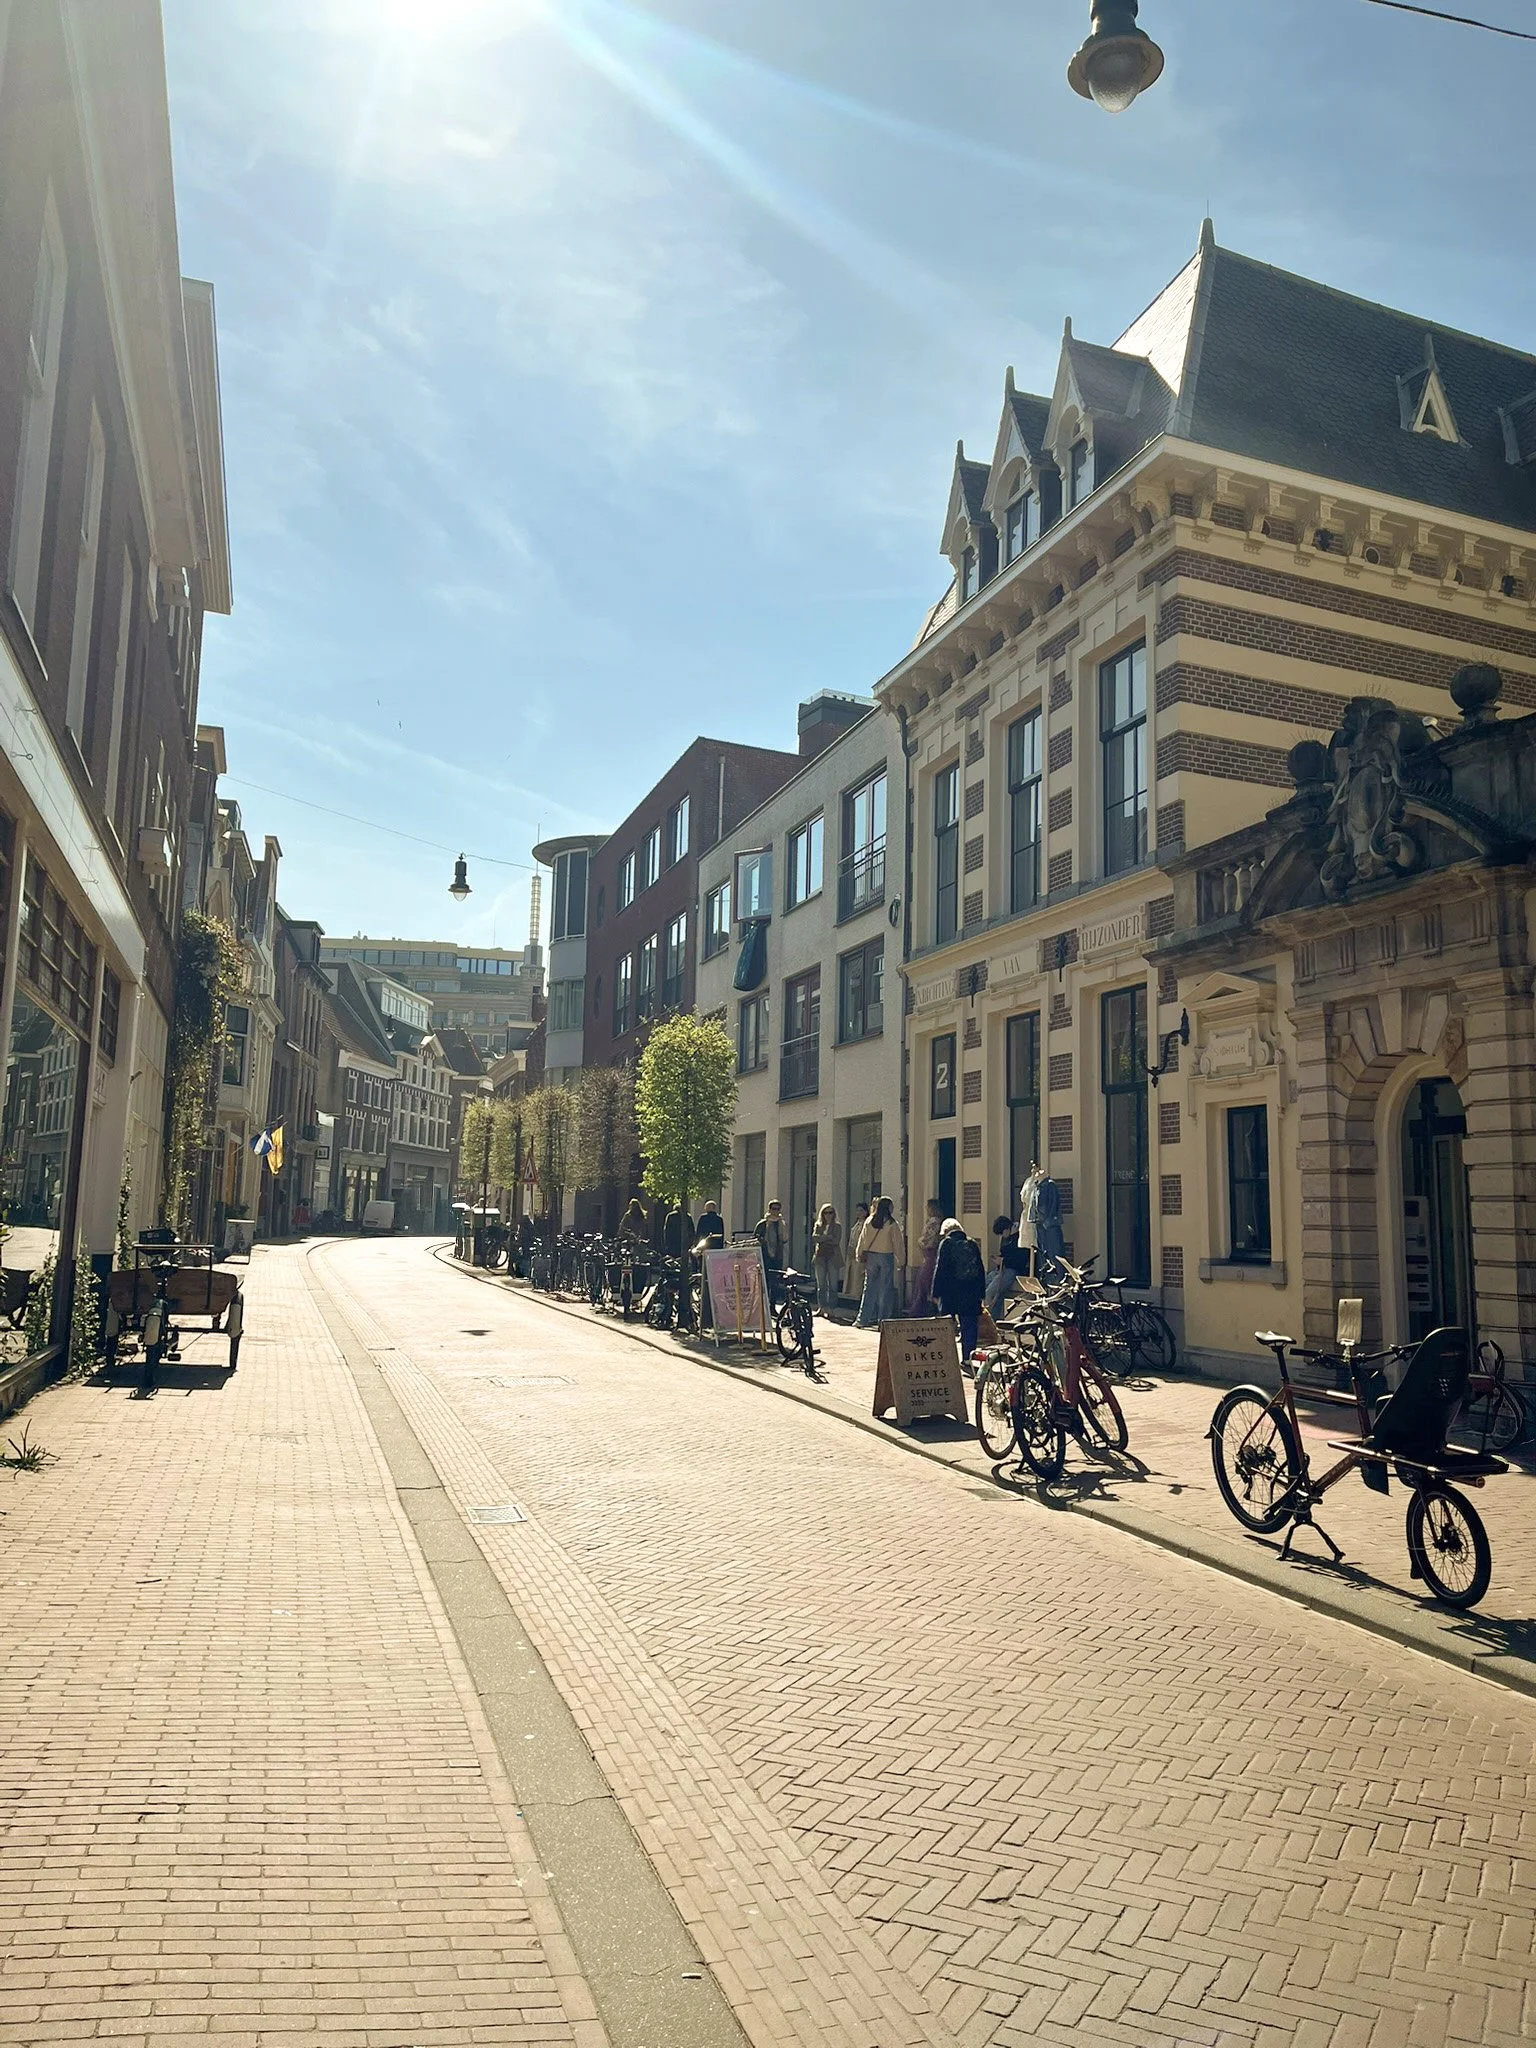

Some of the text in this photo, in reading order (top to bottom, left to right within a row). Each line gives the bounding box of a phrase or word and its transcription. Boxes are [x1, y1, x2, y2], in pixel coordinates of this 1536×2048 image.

[1081, 914, 1140, 951] BIJZONDER
[904, 1351, 944, 1362] BIKES
[907, 1369, 947, 1380] PARTS
[910, 1387, 950, 1398] SERVICE
